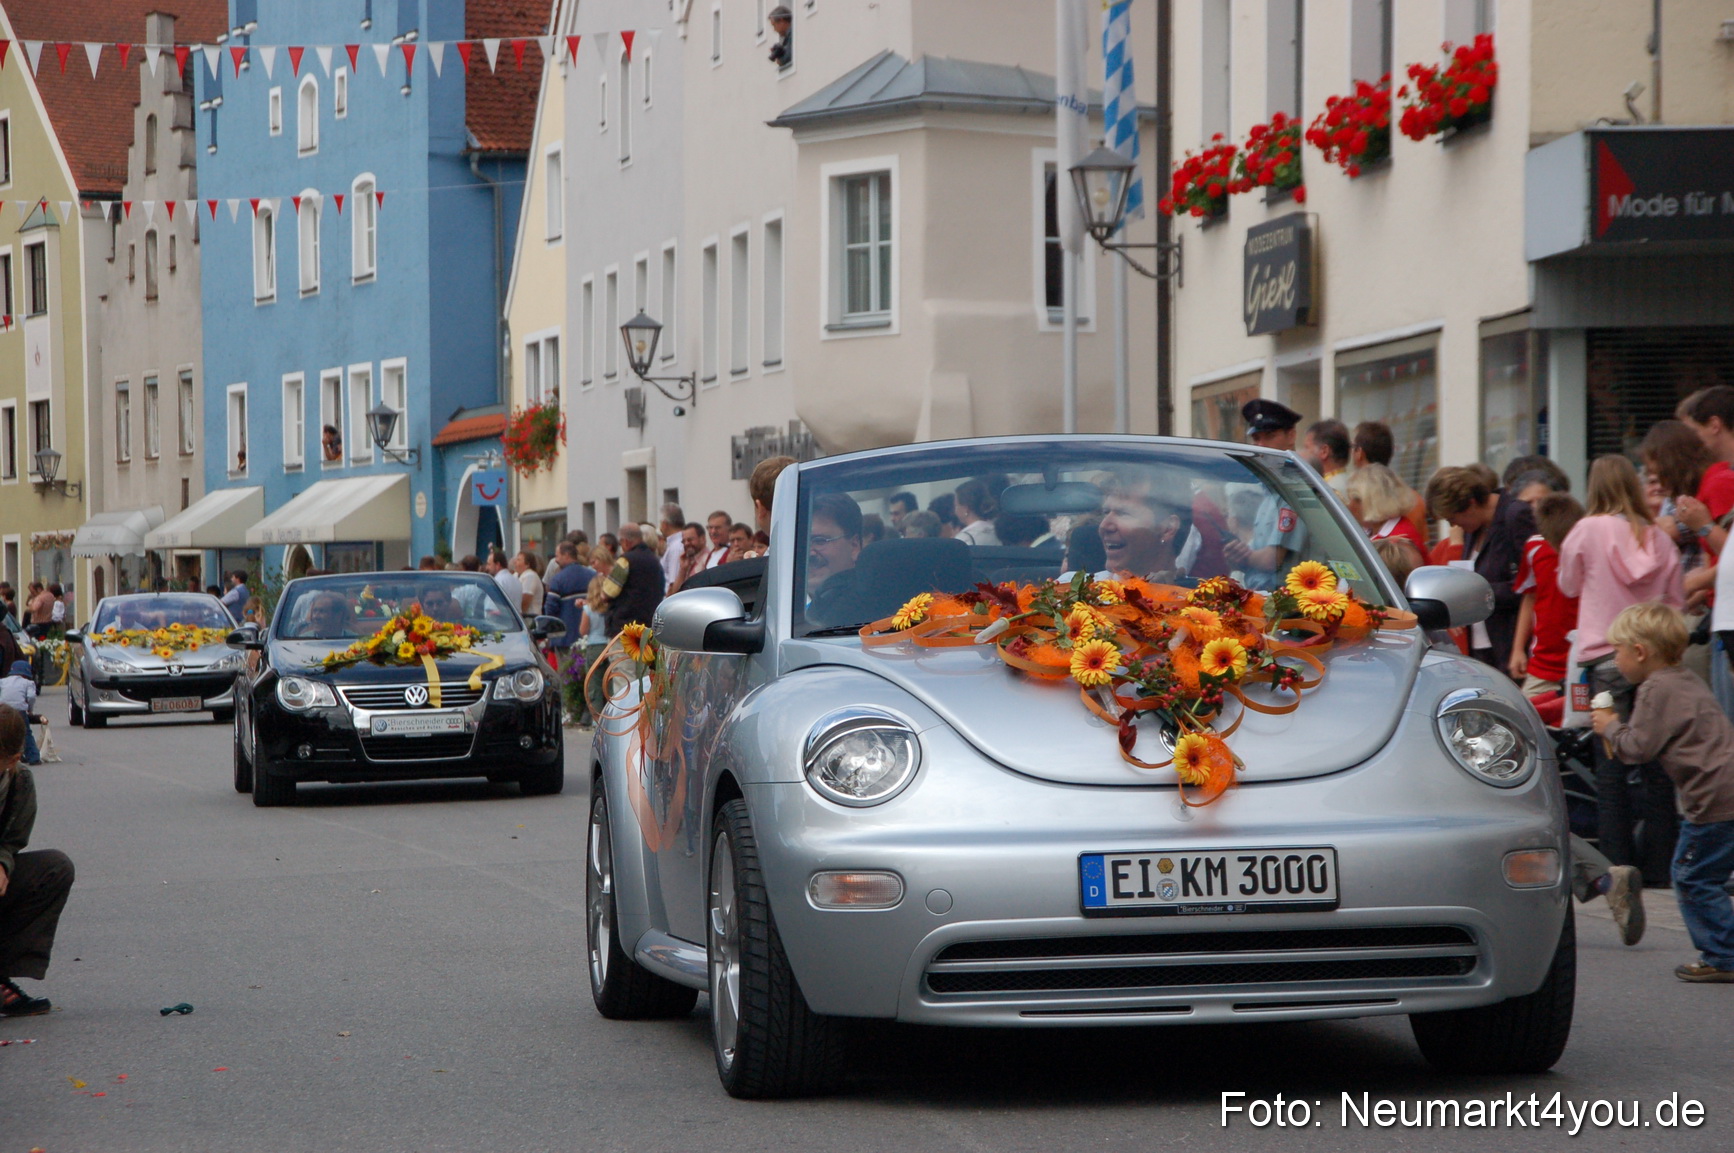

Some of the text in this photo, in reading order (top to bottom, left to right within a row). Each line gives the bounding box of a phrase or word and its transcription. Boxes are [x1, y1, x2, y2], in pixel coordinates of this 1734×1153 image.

[1608, 192, 1679, 218] Mode
[1683, 191, 1716, 215] für
[1248, 226, 1294, 255] MODEZENTRUM
[1111, 854, 1328, 899] EI KM 3000
[1089, 885, 1099, 897] D
